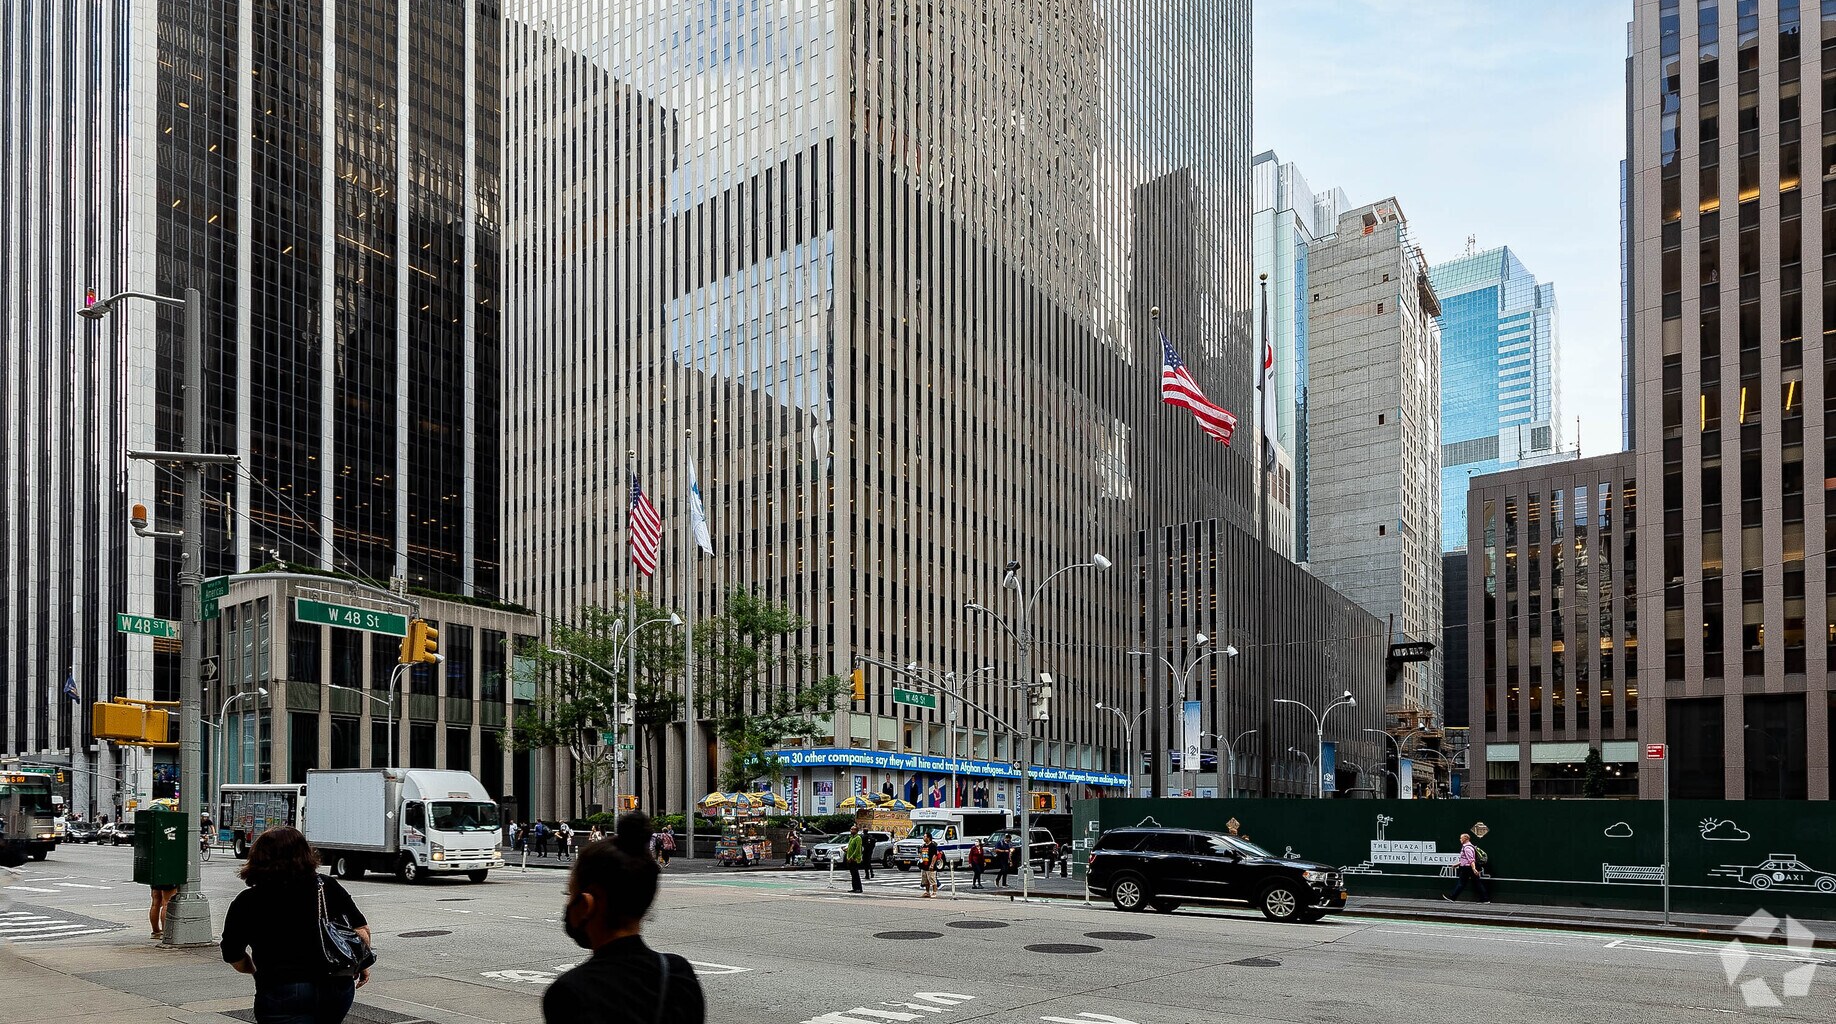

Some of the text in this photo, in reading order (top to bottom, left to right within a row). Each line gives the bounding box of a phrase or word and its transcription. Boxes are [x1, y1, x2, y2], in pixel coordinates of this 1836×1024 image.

[204, 604, 208, 617] 6
[328, 608, 380, 628] W 48 St
[122, 616, 164, 634] W 48 ST
[792, 752, 803, 764] 30
[804, 750, 826, 762] other
[828, 753, 874, 766] companies
[876, 756, 888, 768] say
[890, 754, 904, 769] they
[905, 756, 918, 768] will
[918, 756, 931, 768] hire
[932, 758, 944, 770] and
[945, 760, 960, 771] tran
[960, 761, 980, 774] Afghan
[1044, 768, 1058, 779] about
